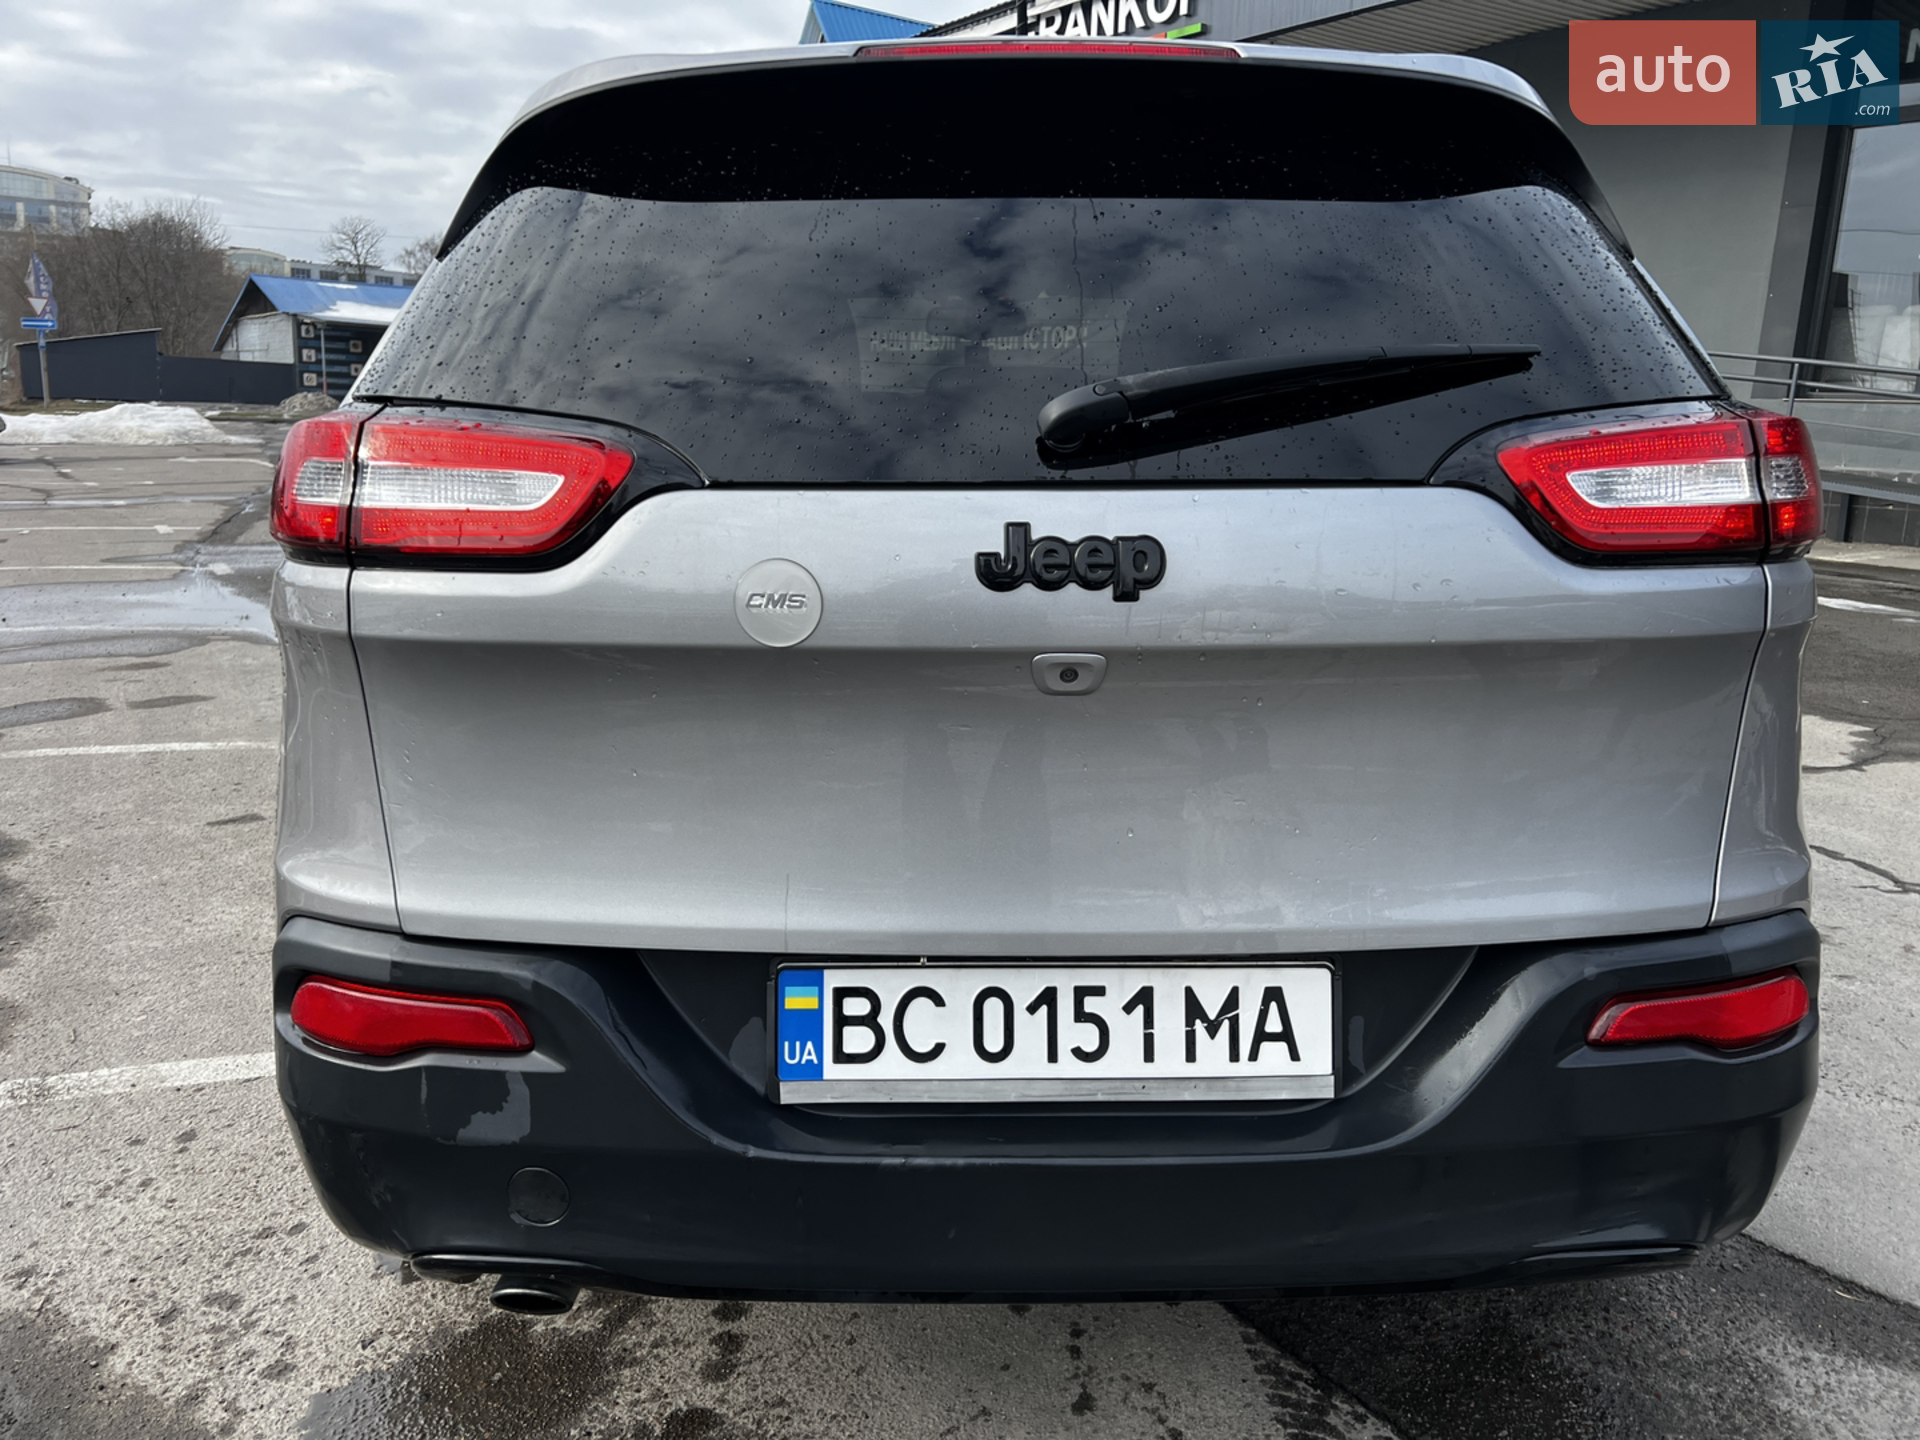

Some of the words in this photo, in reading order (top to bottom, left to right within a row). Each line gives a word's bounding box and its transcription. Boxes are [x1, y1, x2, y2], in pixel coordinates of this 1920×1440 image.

[974, 521, 1167, 603] Jeep
[745, 593, 807, 609] CMS
[831, 985, 947, 1064] BC
[971, 985, 1155, 1064] 0151
[1184, 985, 1302, 1064] MA
[783, 1041, 818, 1065] UA
